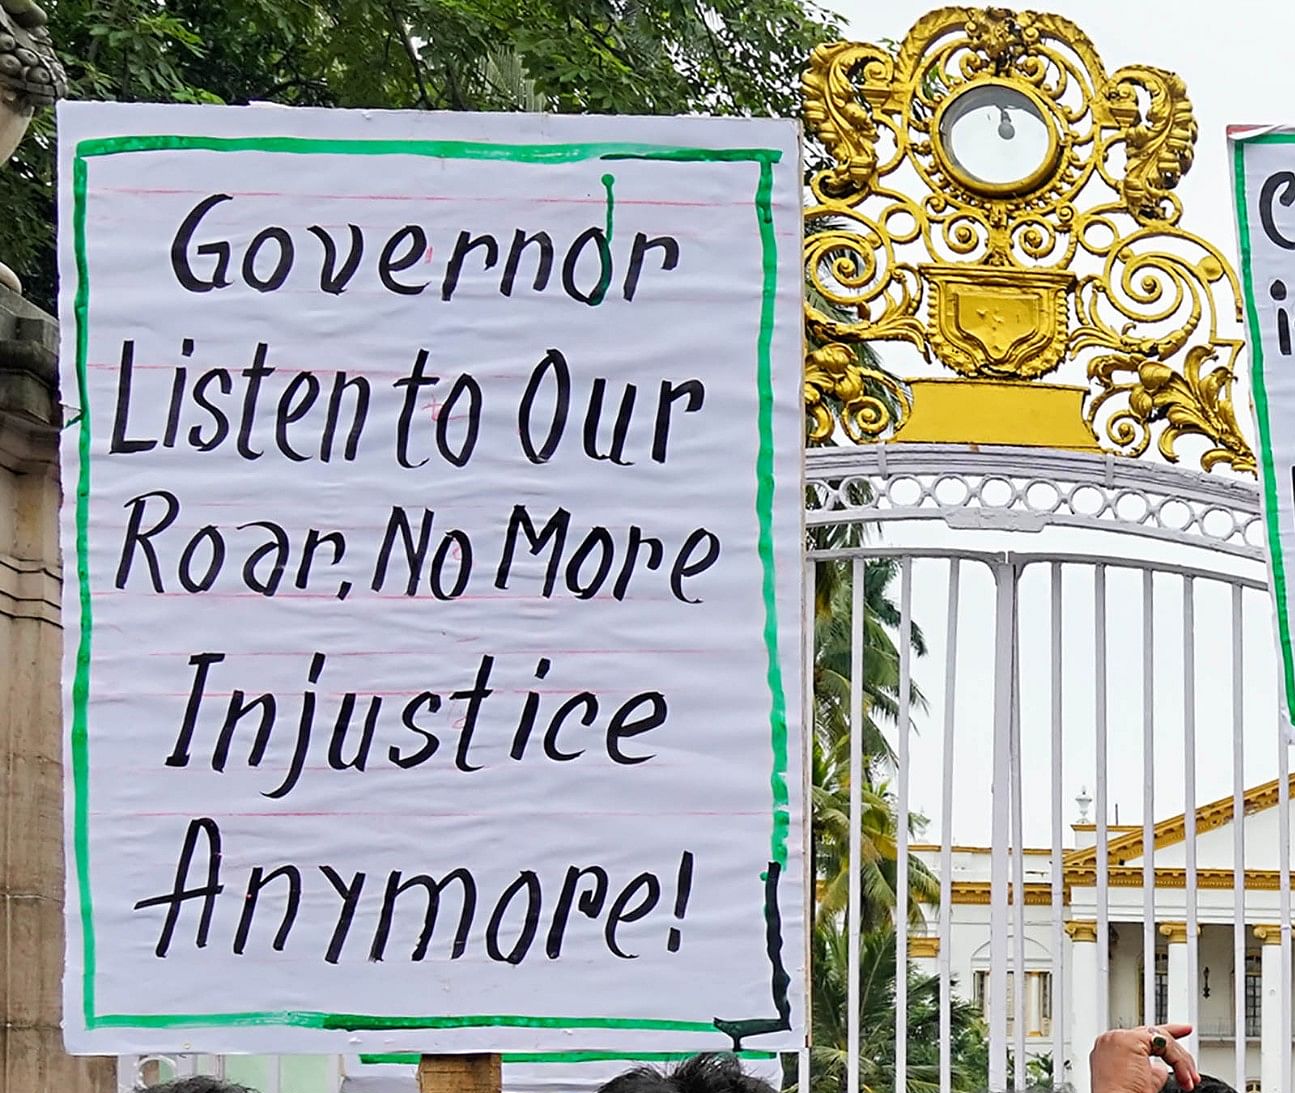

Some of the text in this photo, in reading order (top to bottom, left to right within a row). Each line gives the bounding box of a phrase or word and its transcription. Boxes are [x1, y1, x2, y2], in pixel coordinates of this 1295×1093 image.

[171, 194, 679, 306] Governor
[109, 339, 705, 469] Listen to Our
[116, 490, 720, 604] Roar, No More
[165, 653, 668, 799] Injustice
[134, 818, 693, 965] Anymore!
